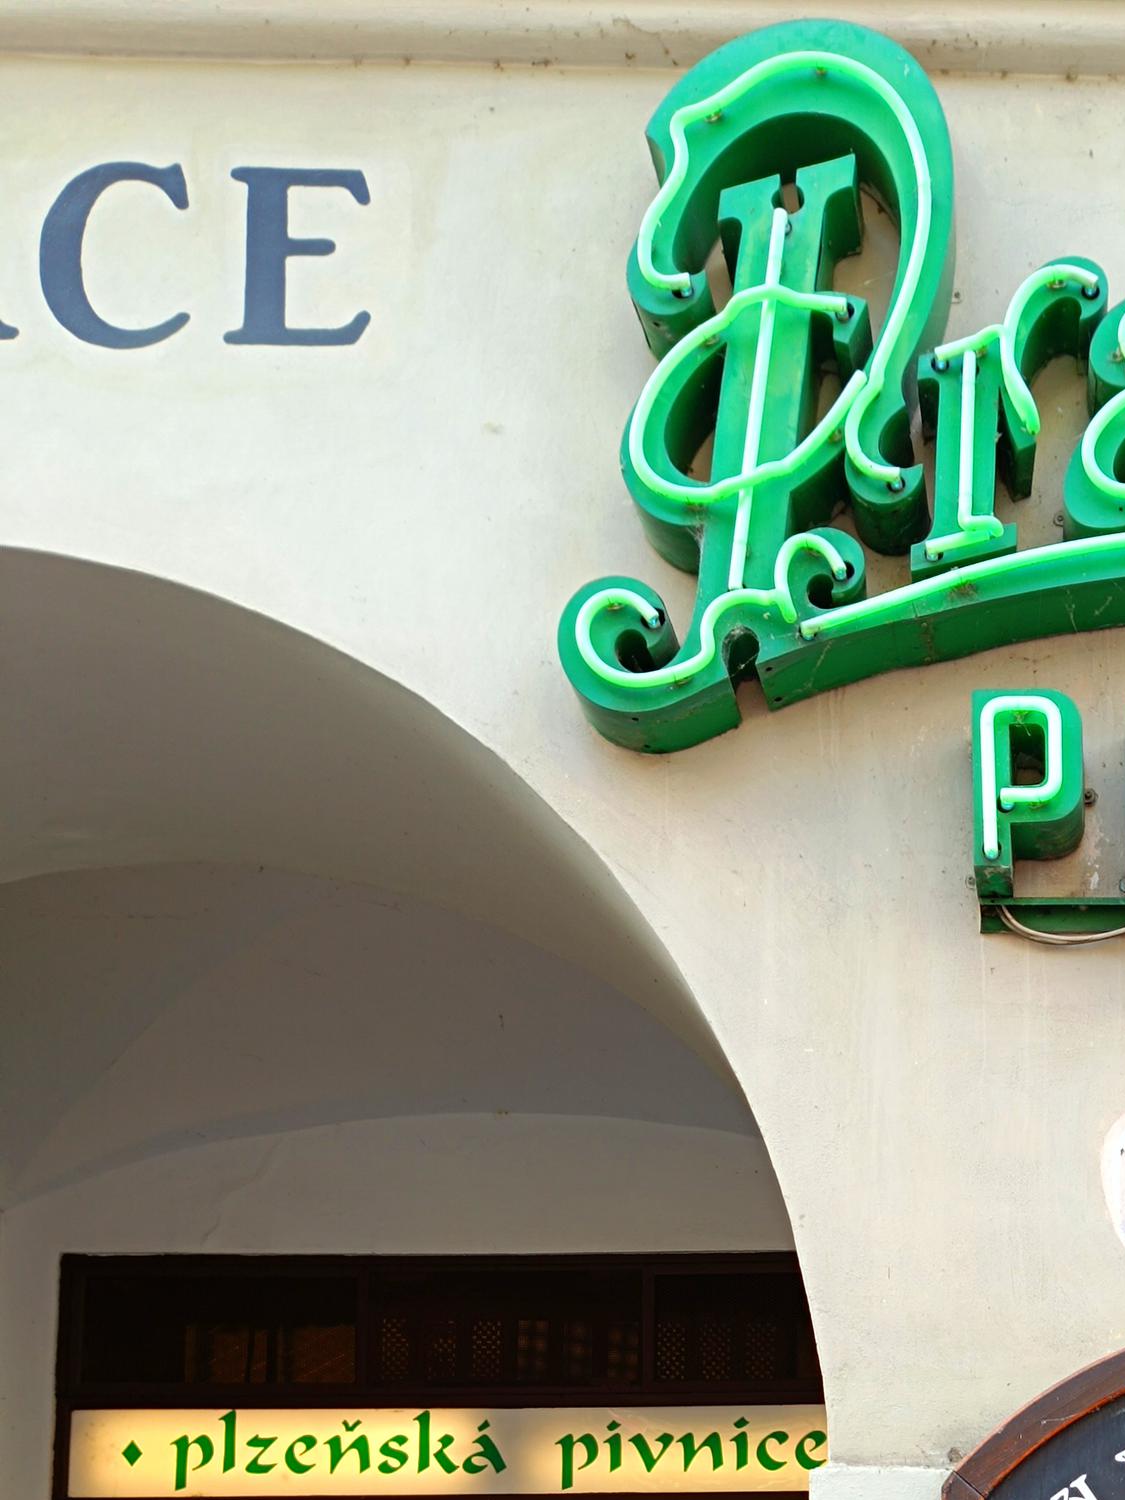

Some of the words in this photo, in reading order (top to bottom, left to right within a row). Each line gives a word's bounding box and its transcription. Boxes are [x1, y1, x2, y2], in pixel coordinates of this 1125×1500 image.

[0, 160, 372, 350] CE
[170, 1409, 508, 1492] plzeňská
[554, 1416, 829, 1491] pivnice
